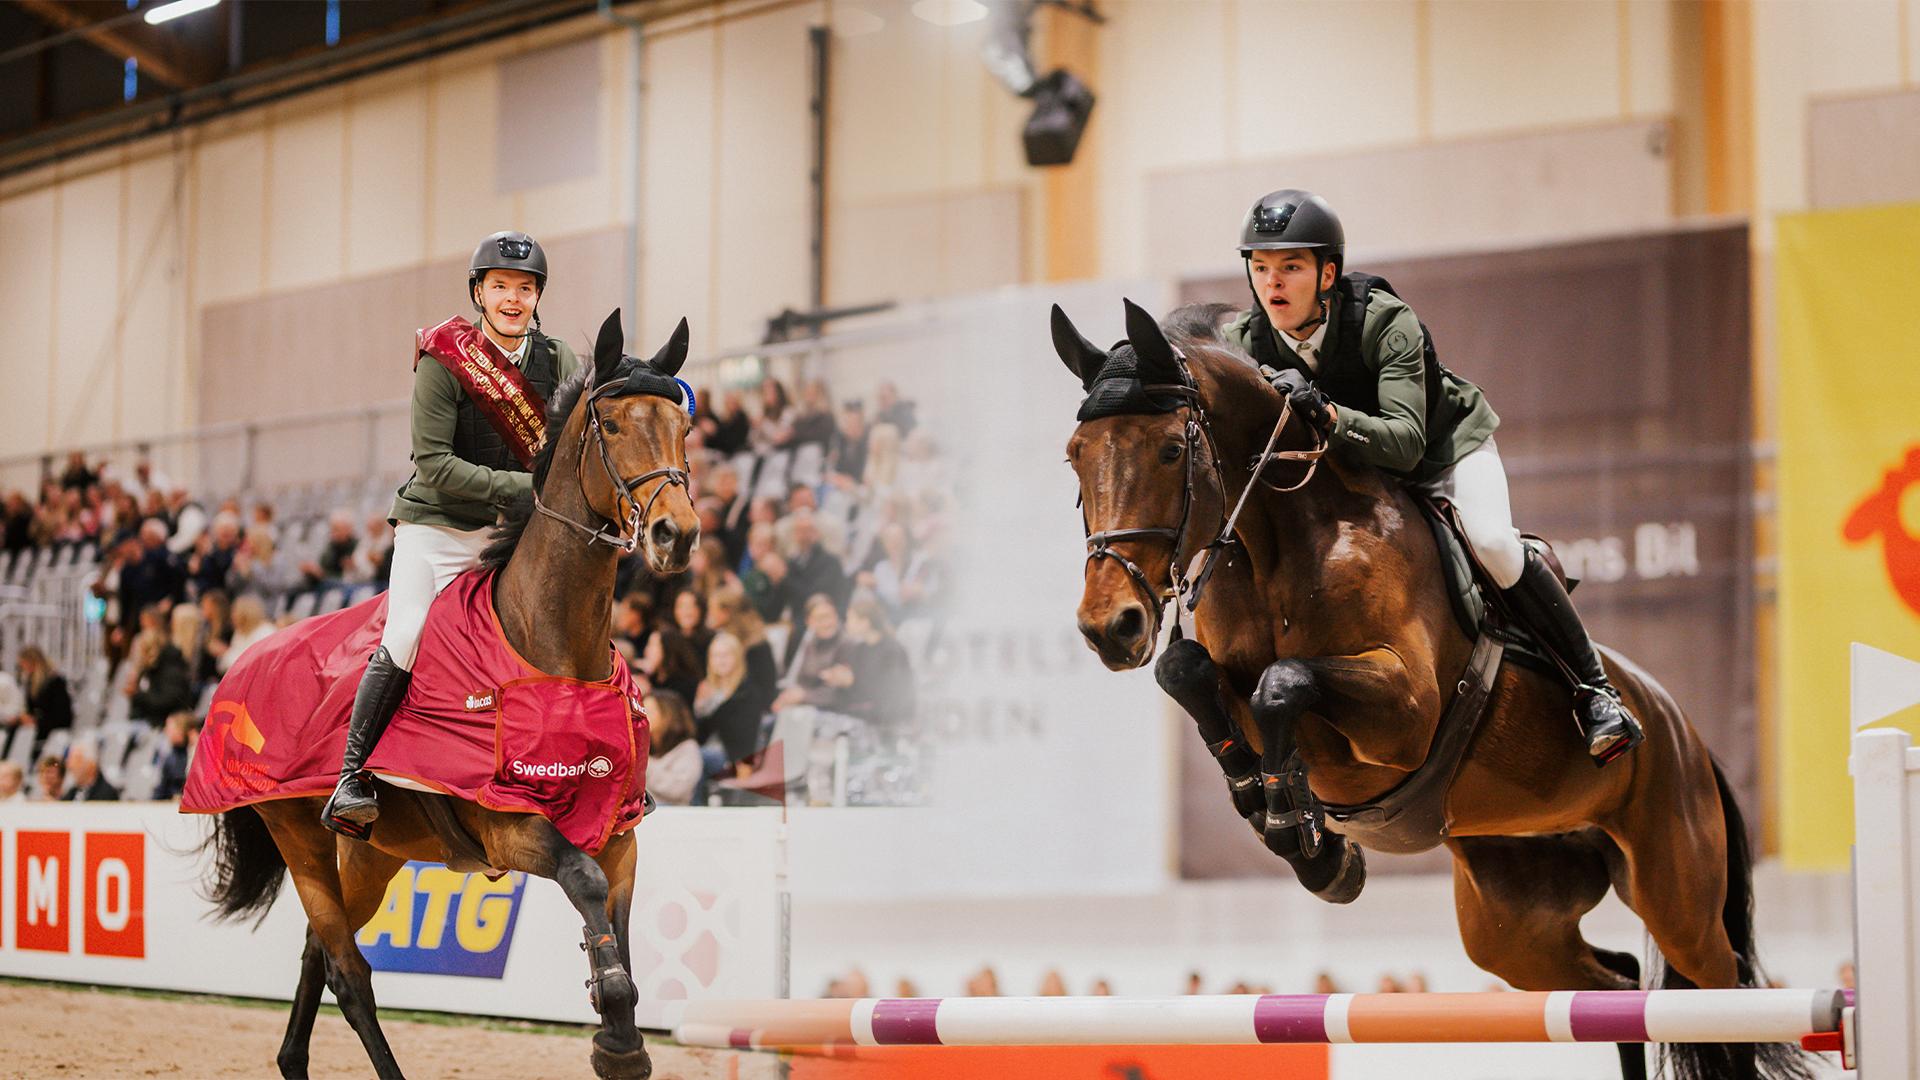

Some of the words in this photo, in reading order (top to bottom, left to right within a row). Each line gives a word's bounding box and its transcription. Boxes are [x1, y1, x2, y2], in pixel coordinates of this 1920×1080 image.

[466, 343, 508, 388] SWEDBANK
[503, 381, 535, 421] UNGDOMS
[512, 759, 588, 777] Swedbank
[355, 865, 516, 954] ATG
